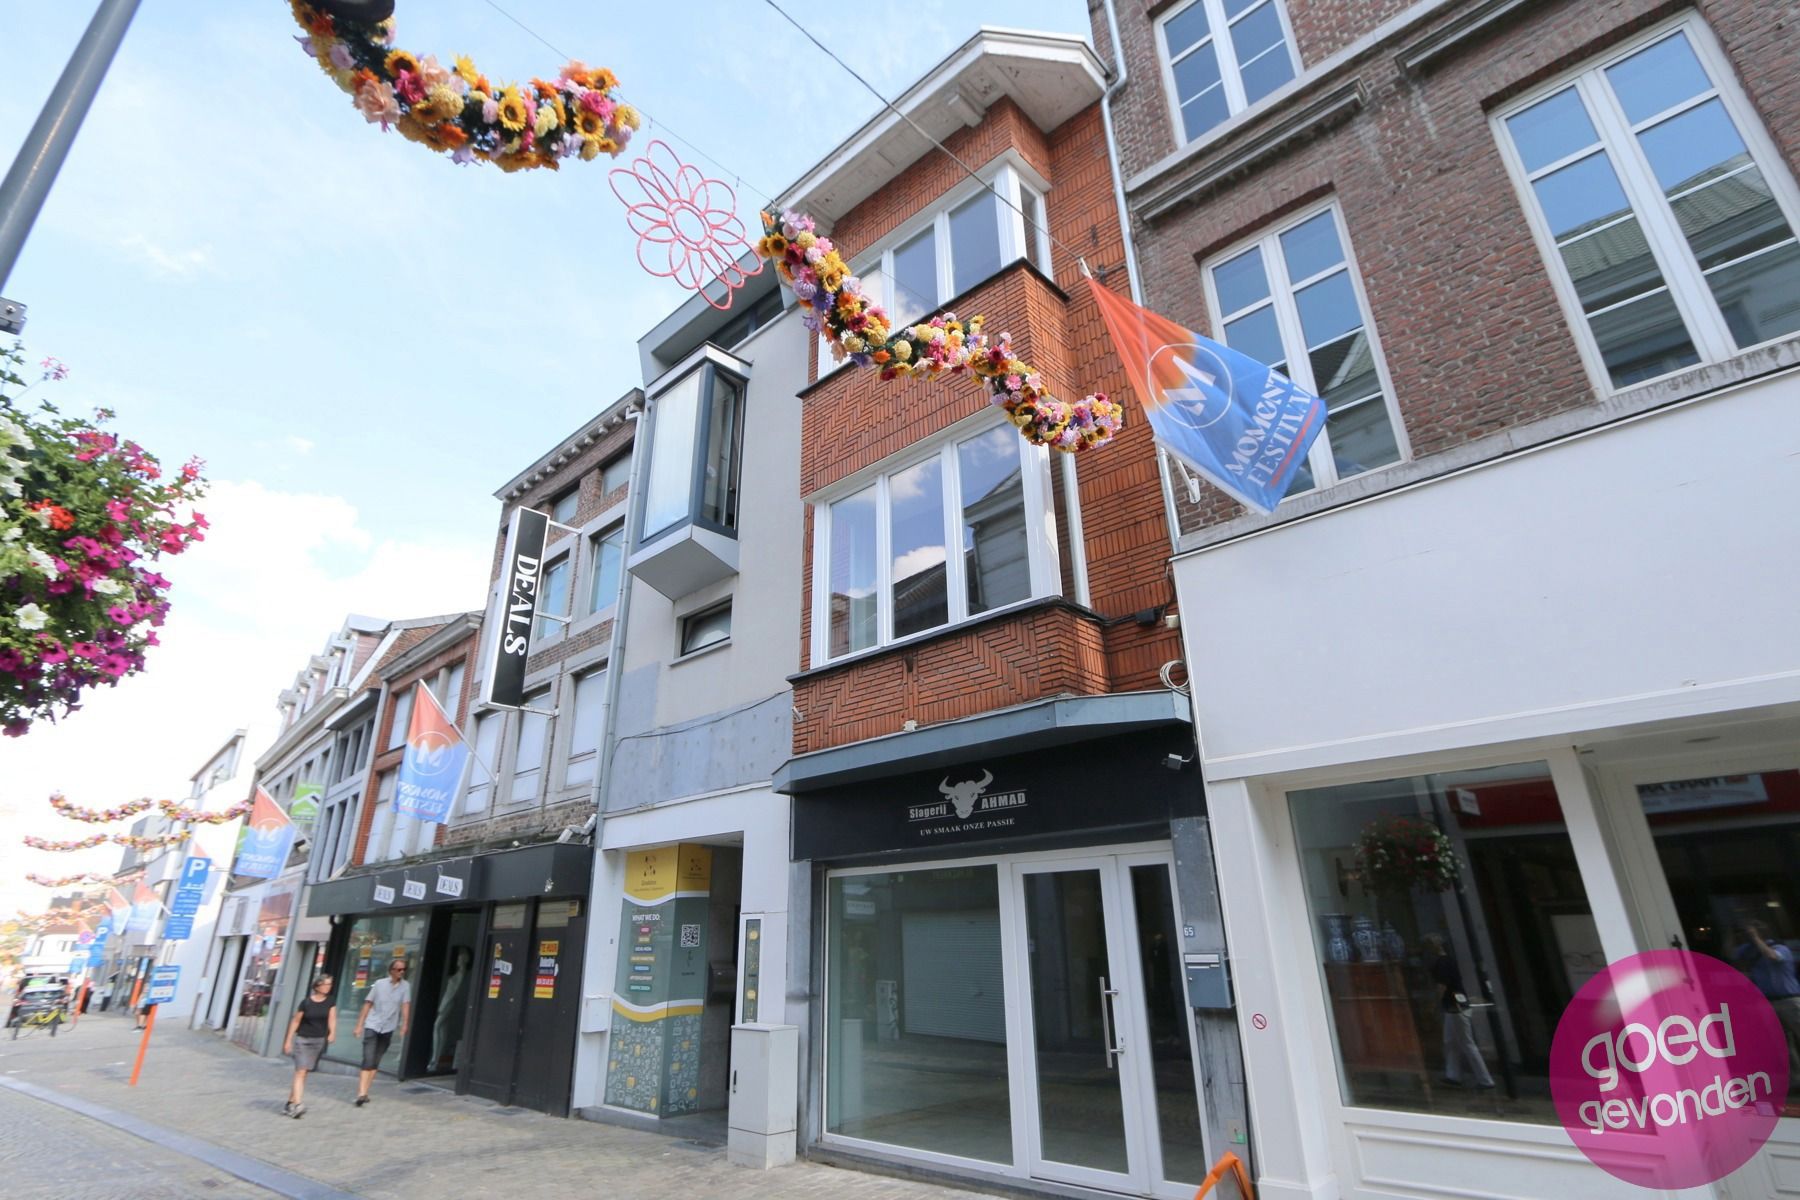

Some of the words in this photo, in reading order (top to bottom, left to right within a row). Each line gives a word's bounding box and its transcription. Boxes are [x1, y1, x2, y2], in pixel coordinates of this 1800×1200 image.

[504, 554, 539, 656] DEALS
[909, 804, 947, 819] Slagerij
[981, 792, 1026, 809] AHMAD
[934, 825, 961, 835] SMAAK
[963, 821, 985, 831] ONZE
[987, 818, 1015, 828] PASSIE
[188, 859, 206, 878] P
[1184, 927, 1194, 936] 65
